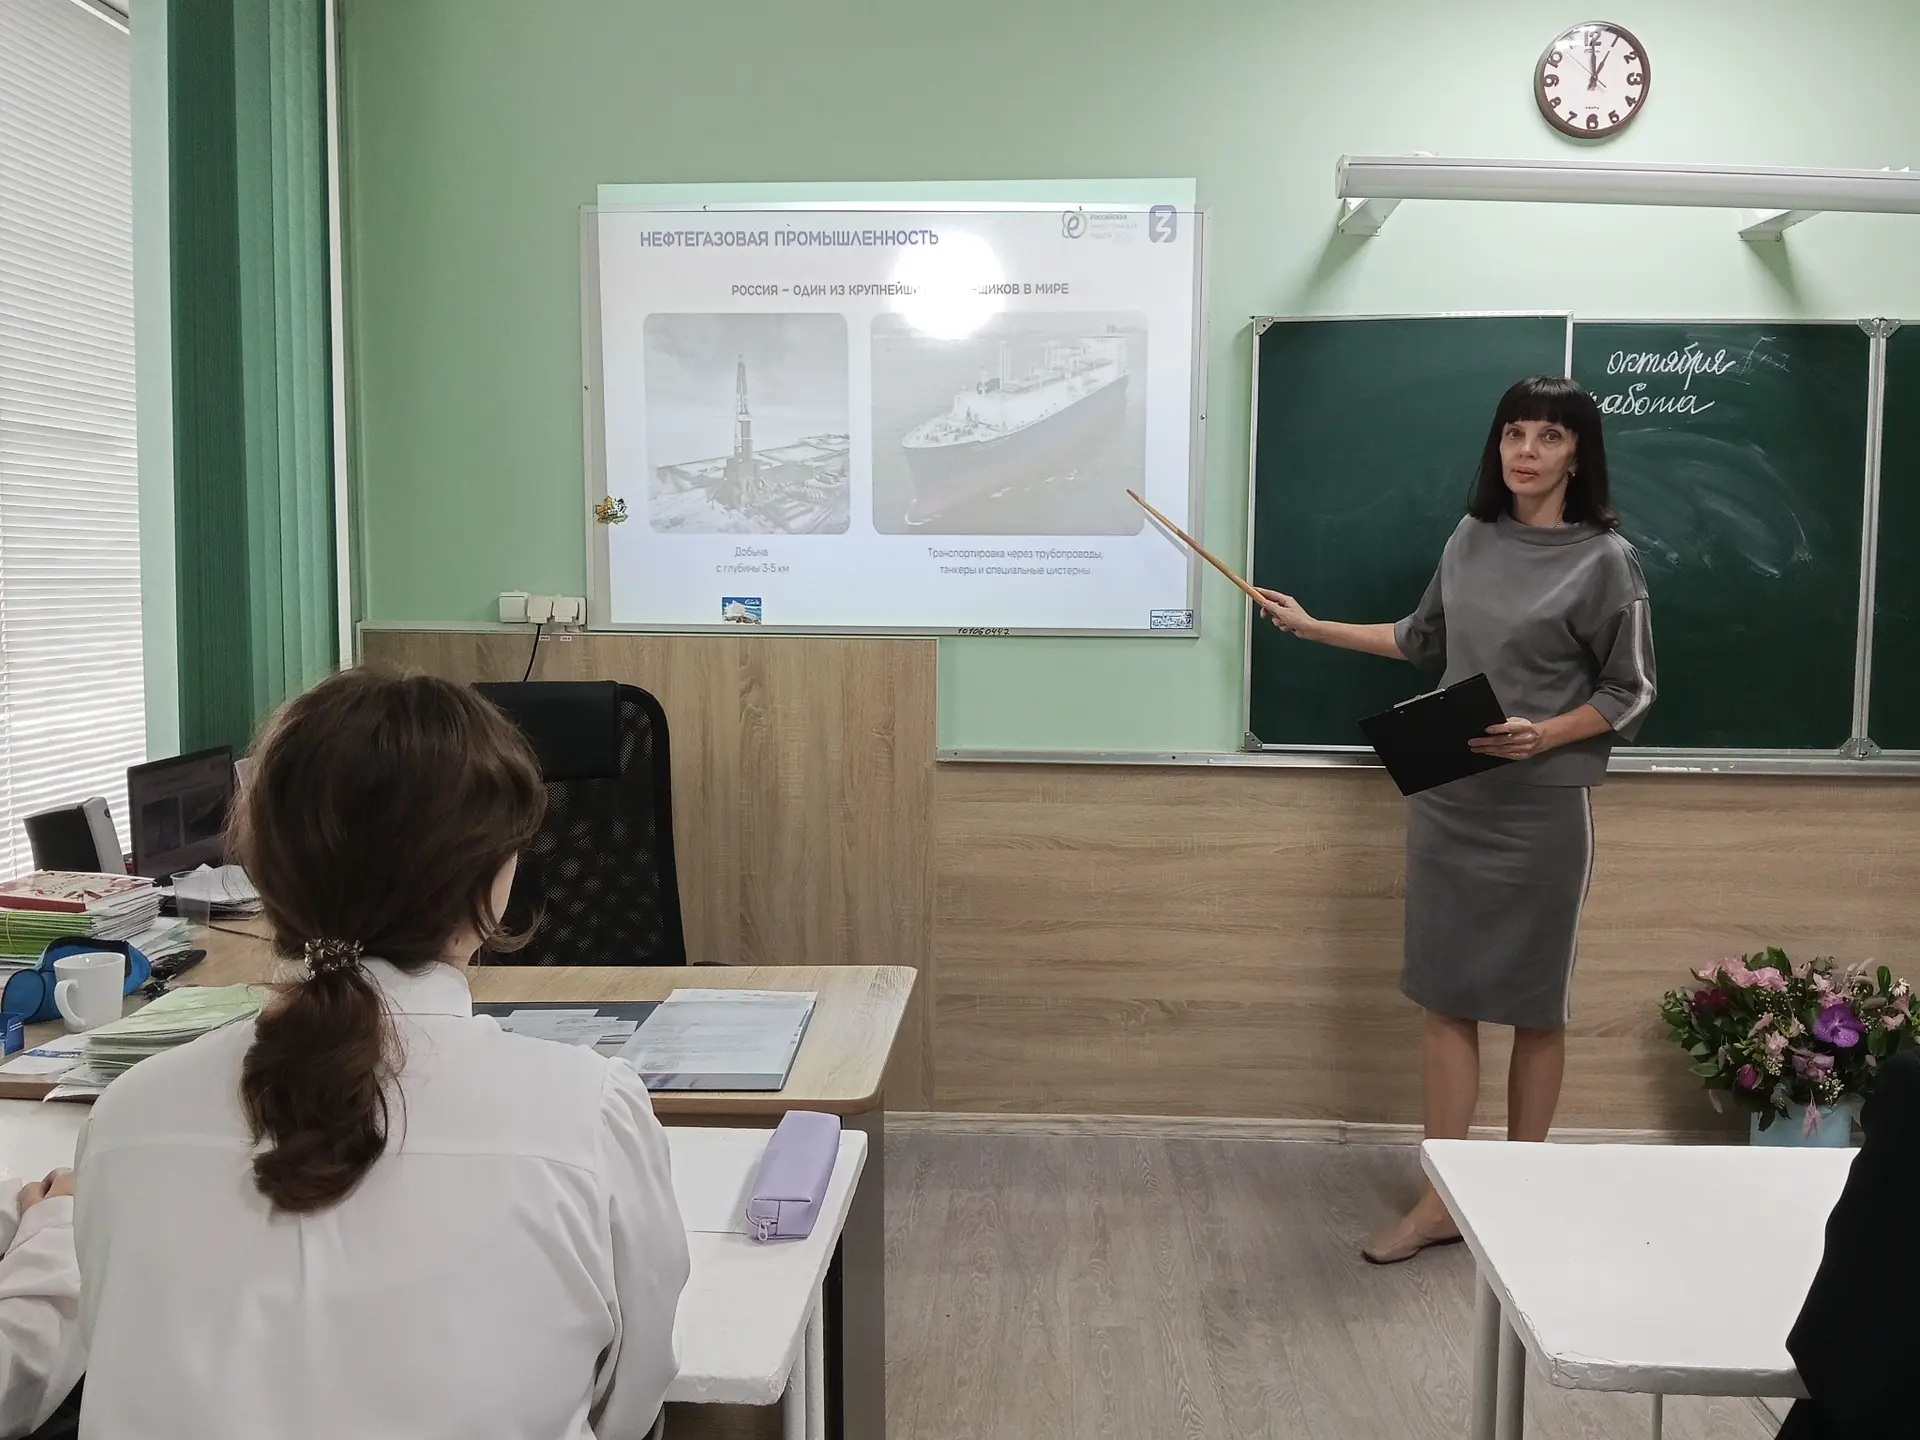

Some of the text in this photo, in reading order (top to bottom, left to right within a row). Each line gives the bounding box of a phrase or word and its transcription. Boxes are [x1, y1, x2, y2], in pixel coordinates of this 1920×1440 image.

[1584, 30, 1602, 47] 12
[1547, 50, 1564, 69] 10
[1623, 51, 1638, 65] 2
[1543, 73, 1560, 88] 9
[1626, 72, 1643, 87] 3
[1549, 96, 1562, 109] 8
[1624, 95, 1638, 108] 4
[1566, 110, 1578, 124] 7
[1586, 113, 1599, 130] 6
[1608, 109, 1620, 124] 5
[640, 229, 939, 247] НЕФТЕГАЗОВАЯ ПРОМЫШЛЕННОСТЬ
[731, 284, 778, 296] РОССИЯ
[793, 284, 826, 298] ОДИН
[830, 284, 845, 296] ИЗ
[1024, 283, 1032, 295] В
[1035, 283, 1069, 295] МИРЕ
[1606, 341, 1736, 390] октября
[734, 546, 768, 557] Добыча
[928, 547, 1005, 560] Транспортировка
[1007, 549, 1033, 560] через
[716, 562, 789, 576] с глубины 3-5 км
[940, 565, 1091, 577] танкеры и специальные цистерны
